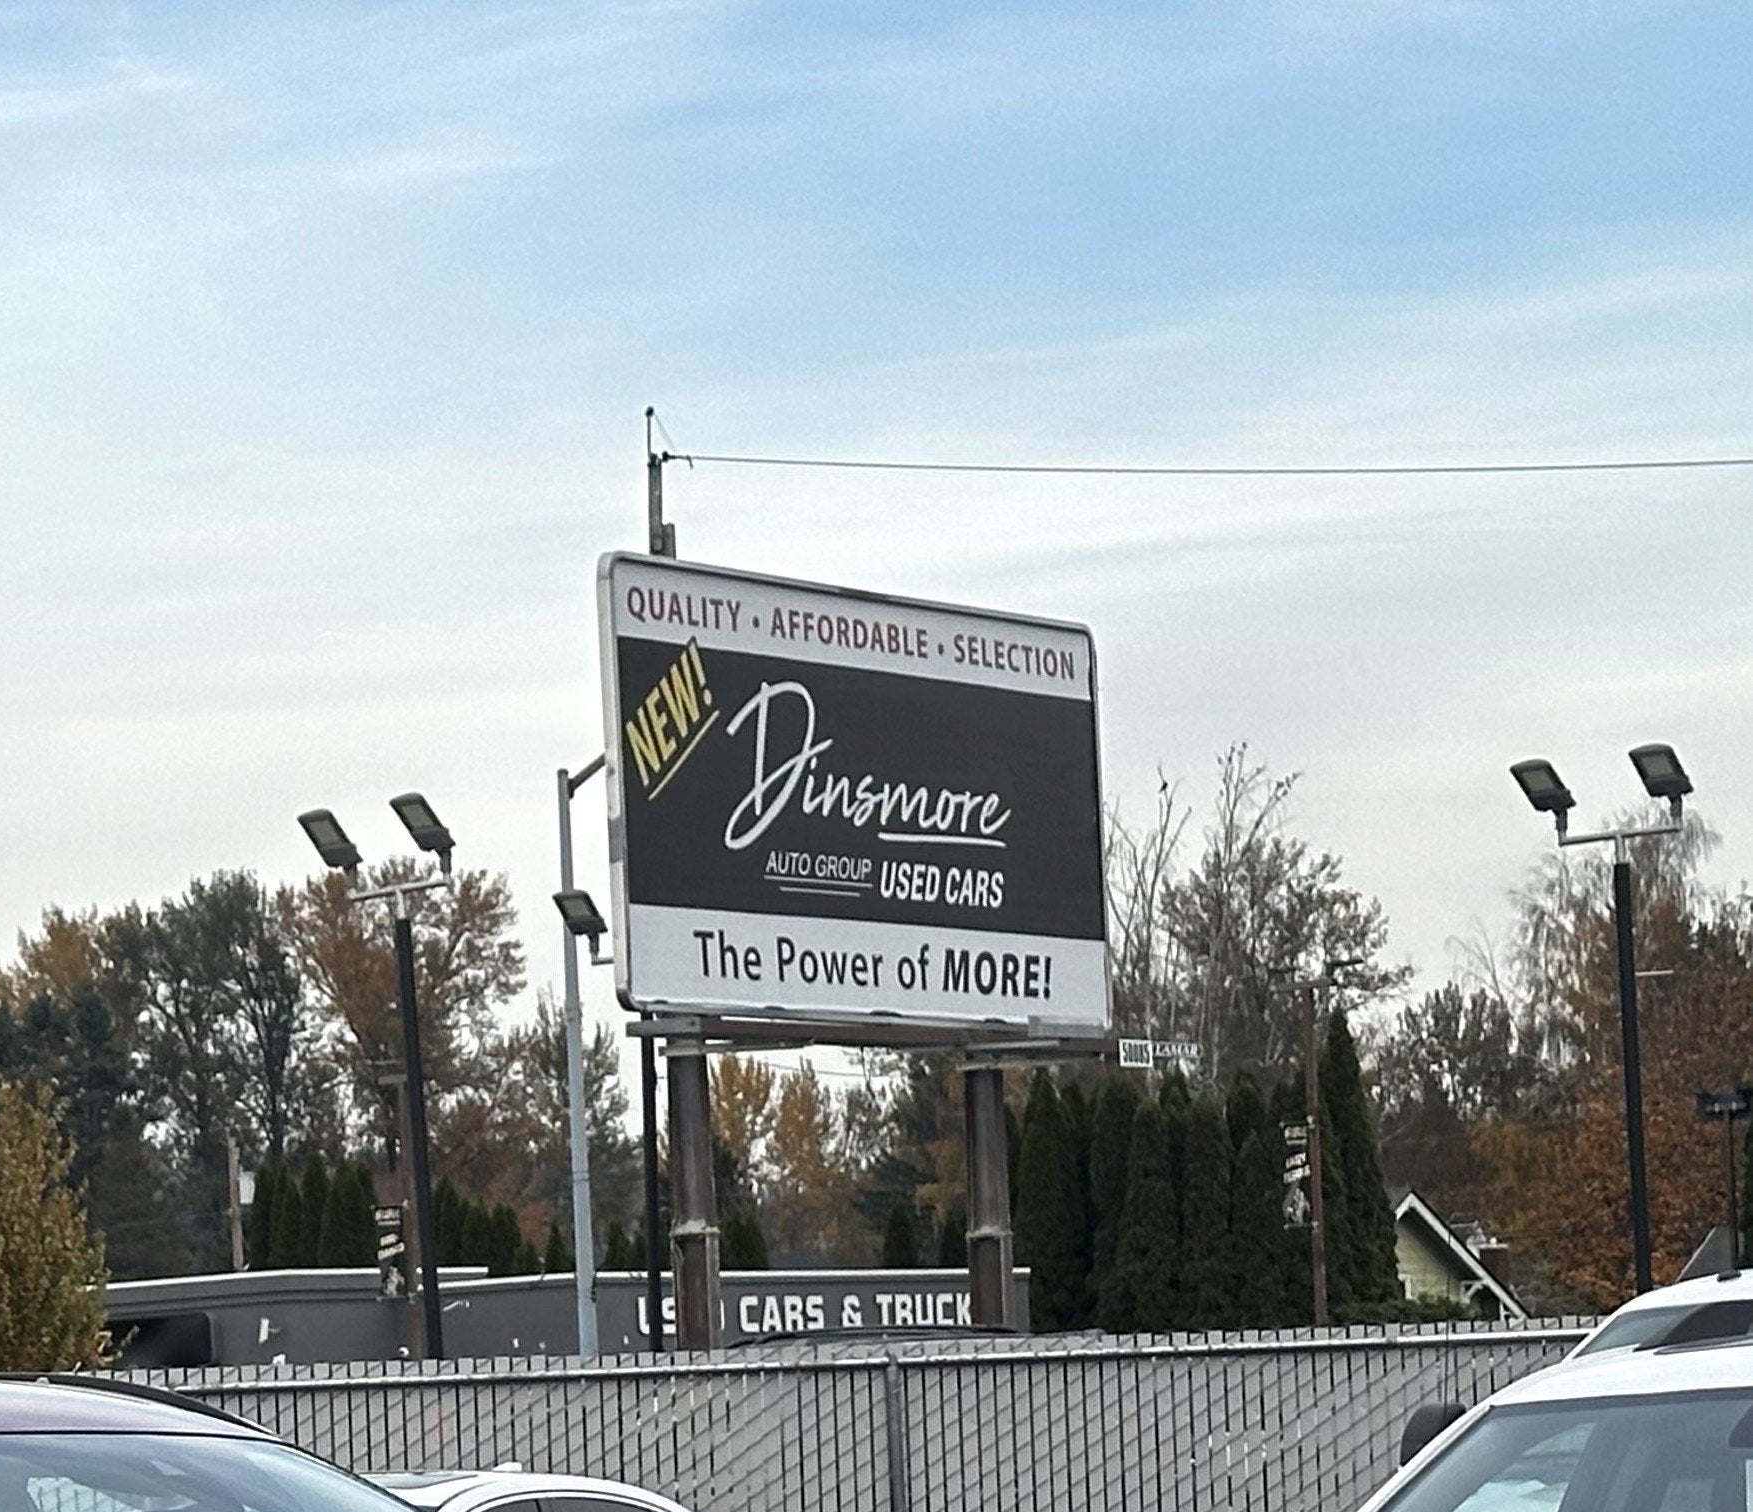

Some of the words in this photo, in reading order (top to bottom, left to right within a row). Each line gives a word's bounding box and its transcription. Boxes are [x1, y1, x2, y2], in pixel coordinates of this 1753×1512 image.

[627, 585, 741, 632] QUALITY
[770, 606, 929, 660] AFFORDABLE
[953, 633, 1075, 680] SELECTION
[624, 639, 712, 786] NEW!
[725, 680, 1012, 850] Dinsmore
[765, 850, 811, 875] AUTO
[815, 854, 872, 881] GROUP
[880, 860, 941, 902] USED
[945, 866, 1005, 908] CARS
[692, 929, 762, 981] The
[776, 936, 884, 987] Power
[897, 943, 930, 990] of
[942, 948, 1052, 1000] MORE!
[739, 1294, 825, 1333] CARS
[842, 1294, 863, 1327] &
